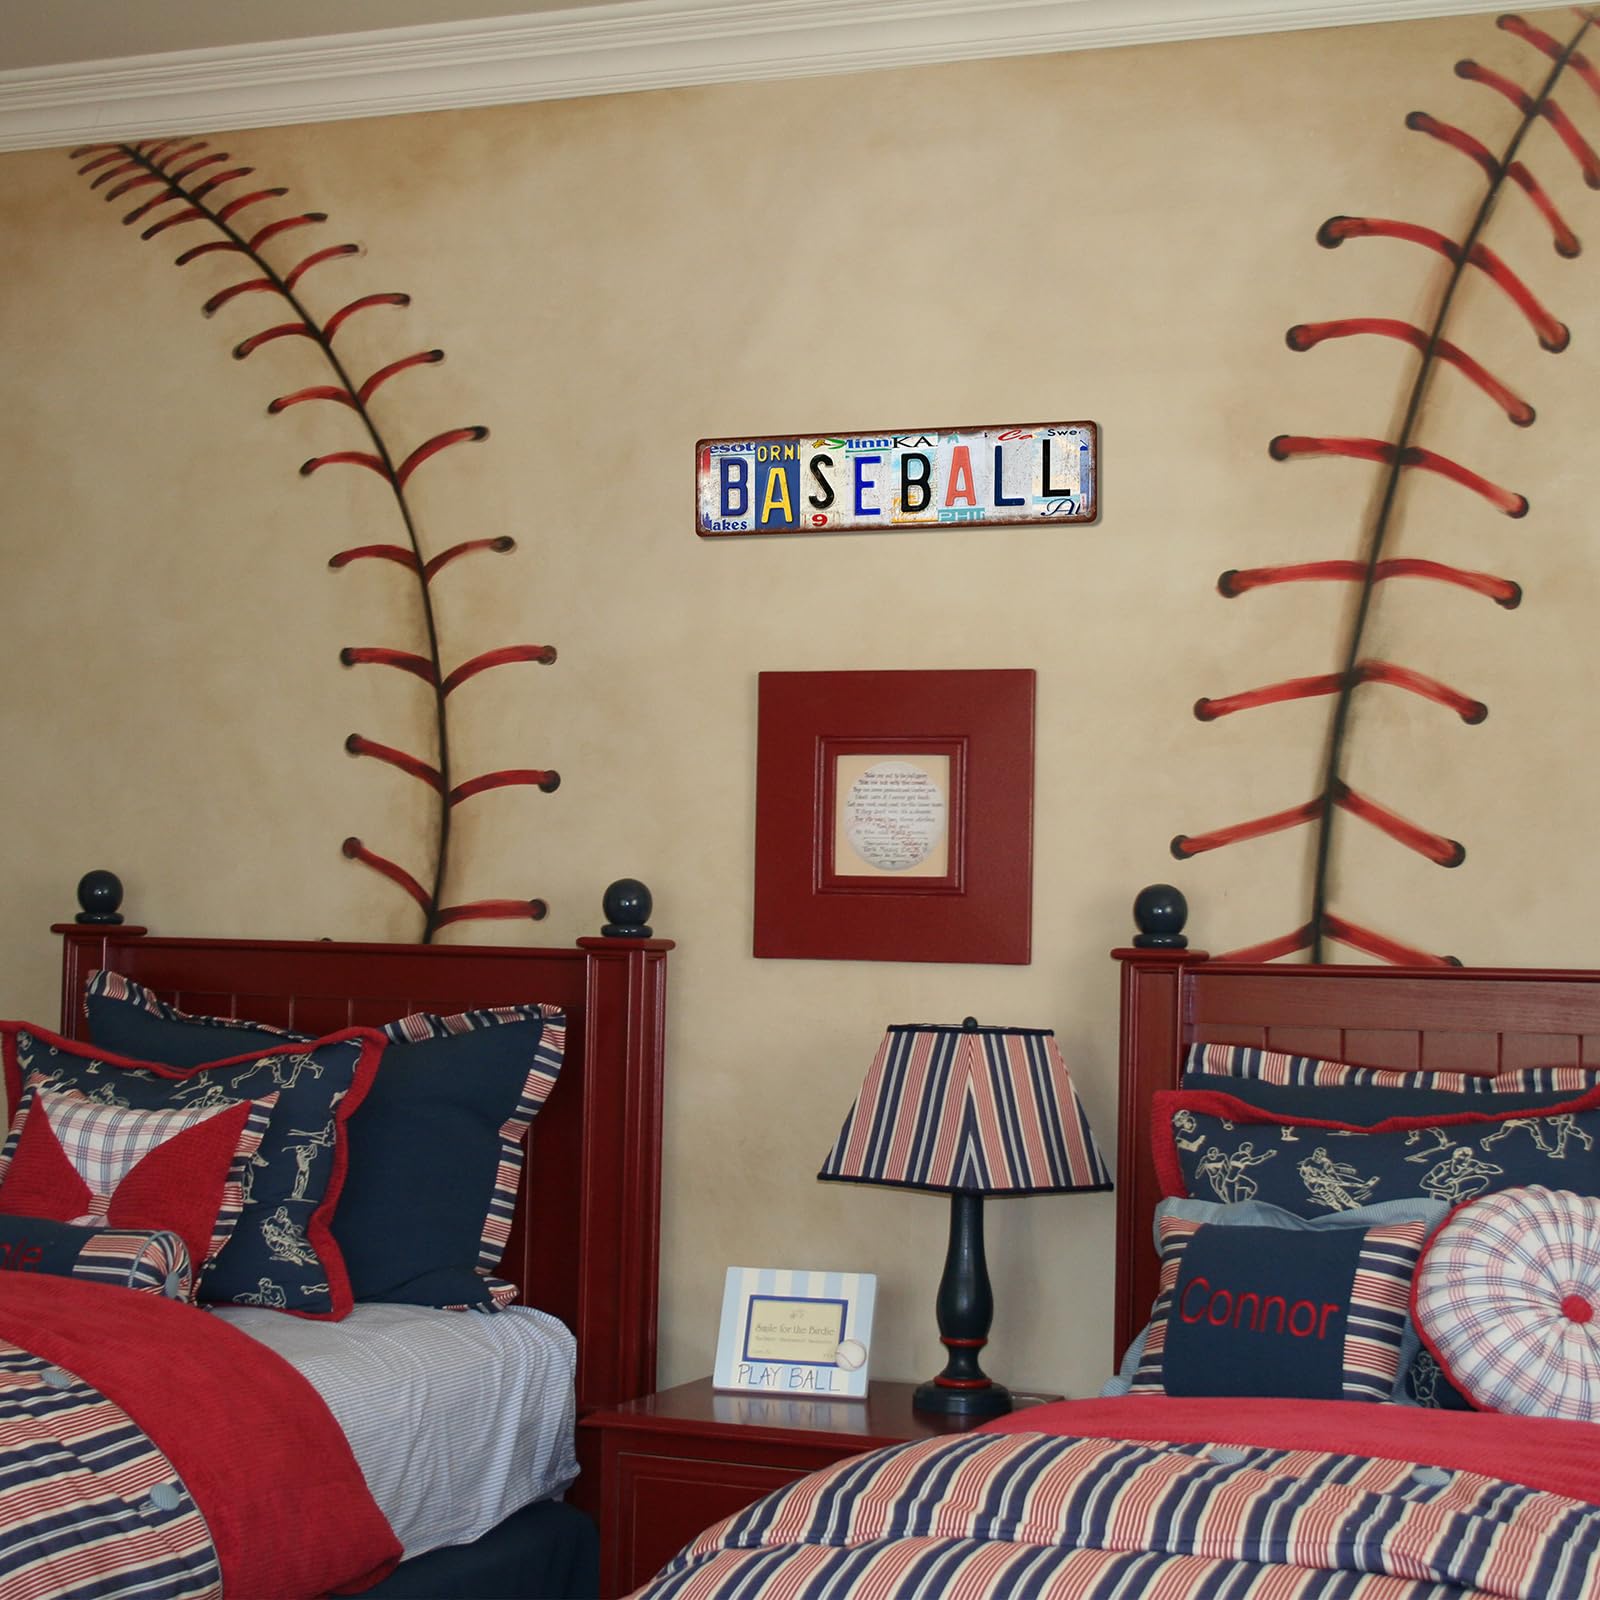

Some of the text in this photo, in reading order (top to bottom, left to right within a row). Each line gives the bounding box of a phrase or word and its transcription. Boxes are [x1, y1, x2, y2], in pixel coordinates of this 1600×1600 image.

[720, 439, 1071, 524] BASEBALL
[811, 513, 828, 527] 9
[1180, 1276, 1340, 1340] Connor
[738, 1364, 841, 1392] PLAY BALL
